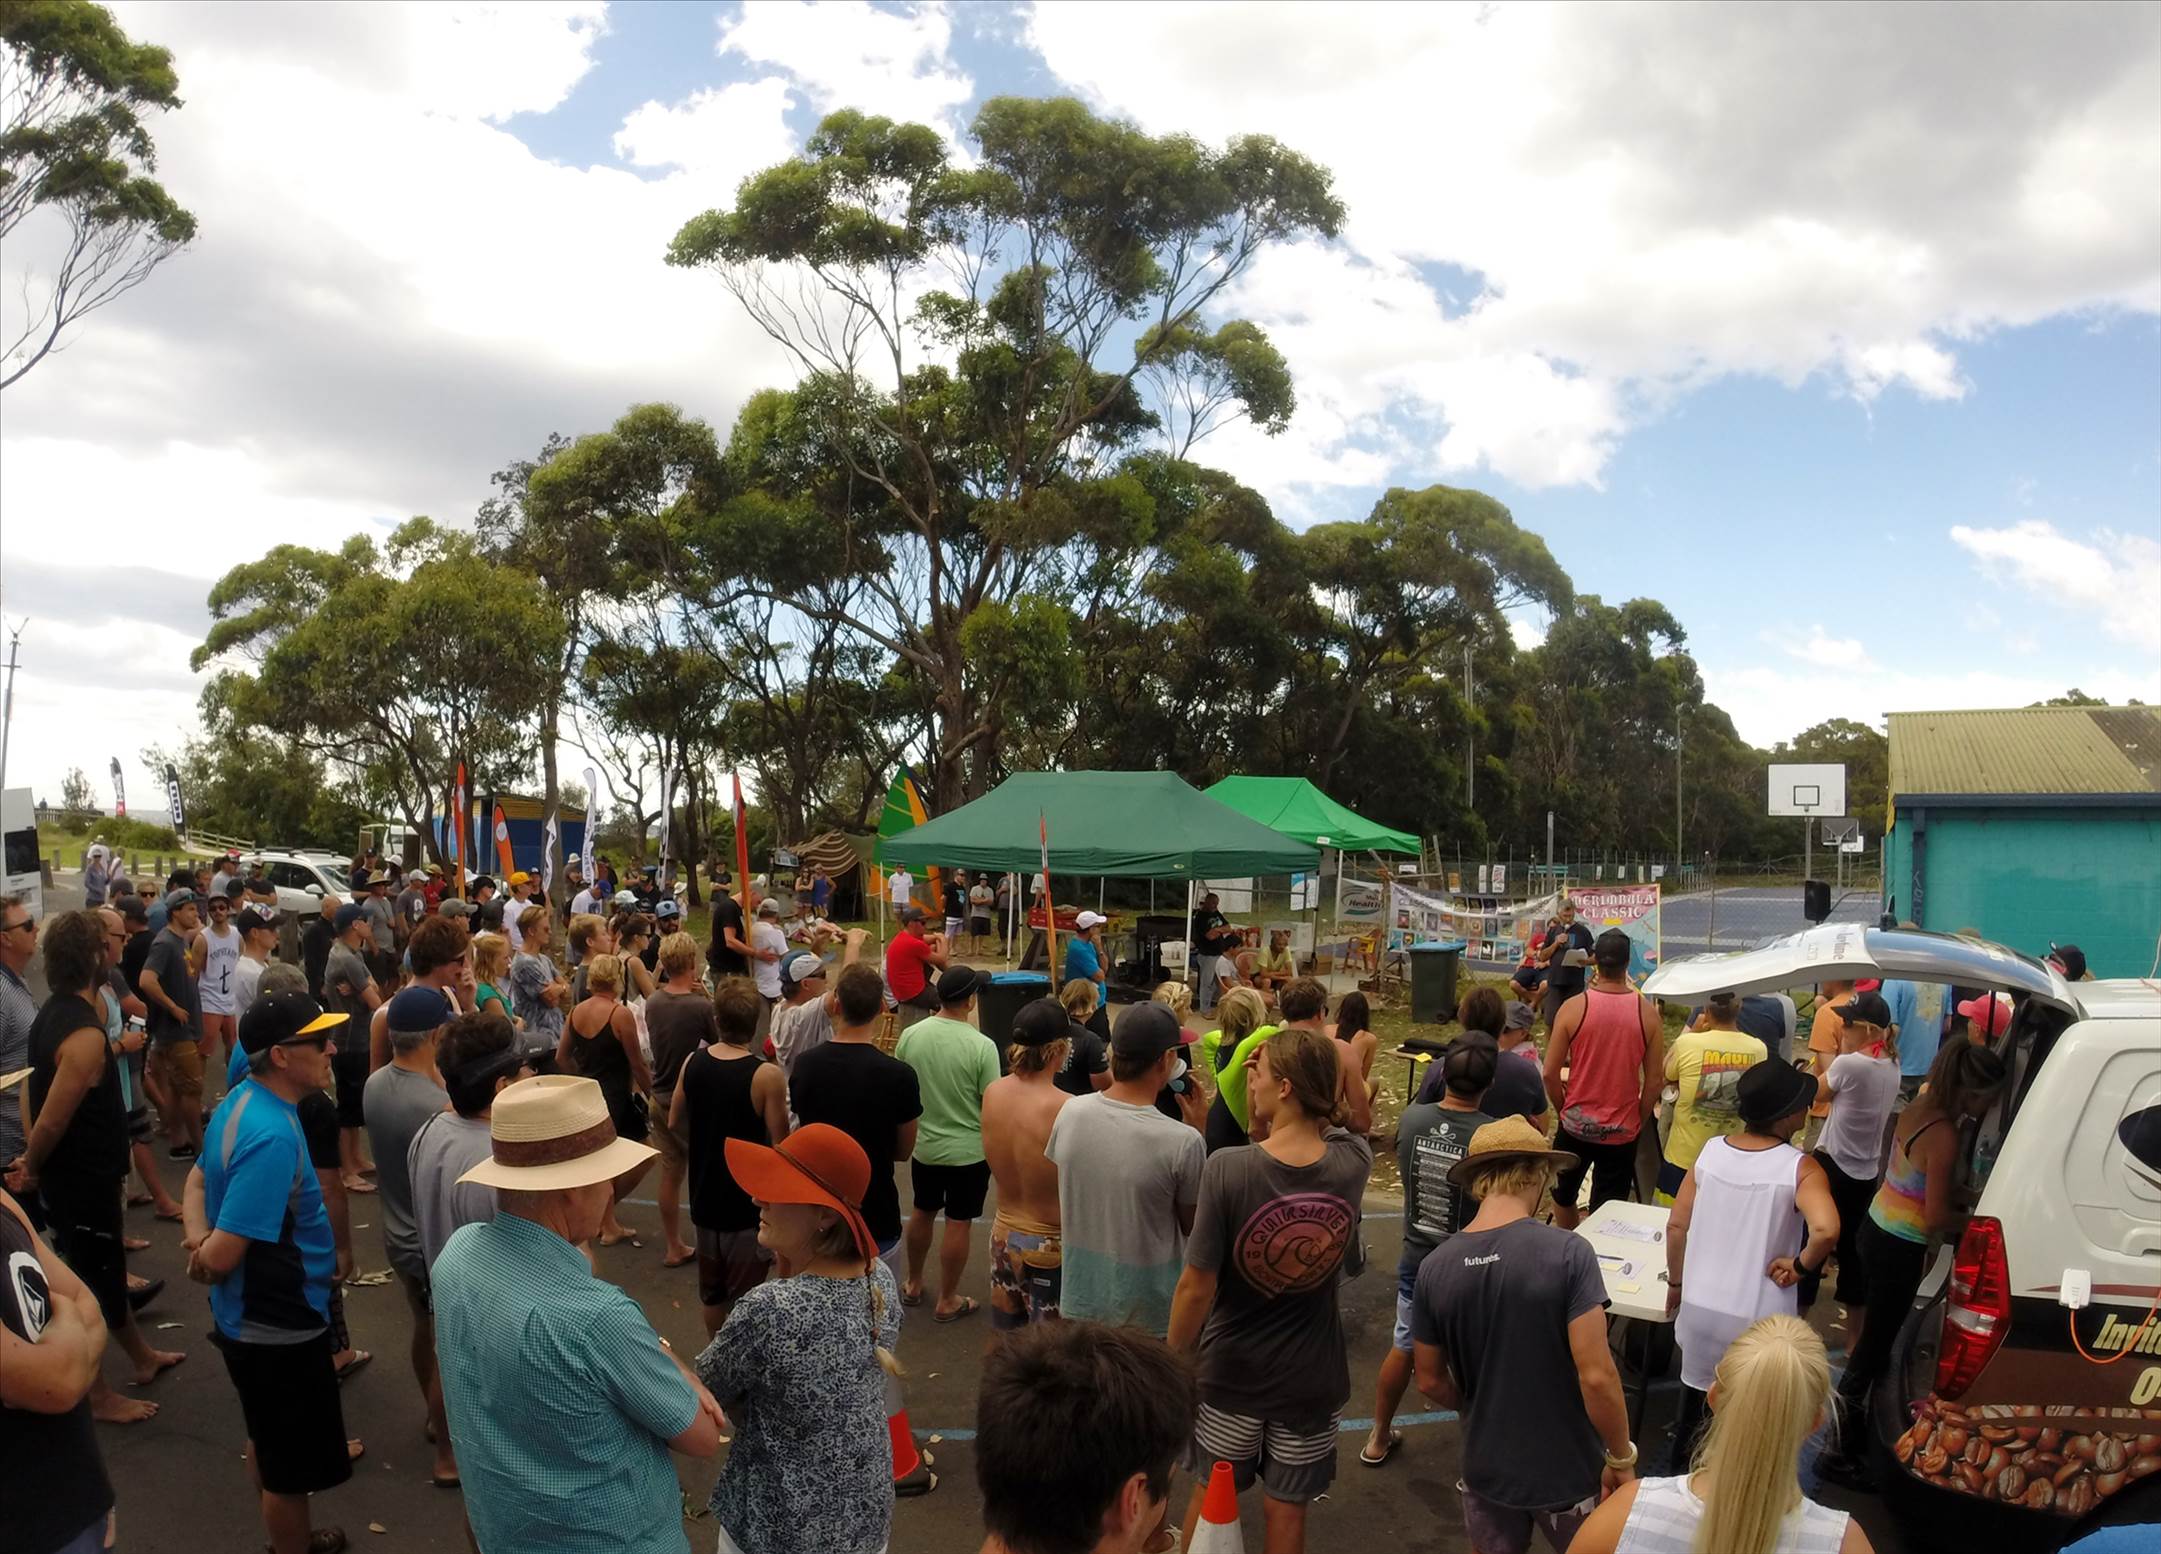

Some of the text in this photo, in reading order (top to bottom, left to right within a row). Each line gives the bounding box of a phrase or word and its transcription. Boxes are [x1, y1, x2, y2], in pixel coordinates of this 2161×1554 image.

[1571, 894, 1655, 907] MERIMBULA
[1582, 906, 1642, 918] CLASSIC
[1417, 1138, 1463, 1156] ANTARCTICA
